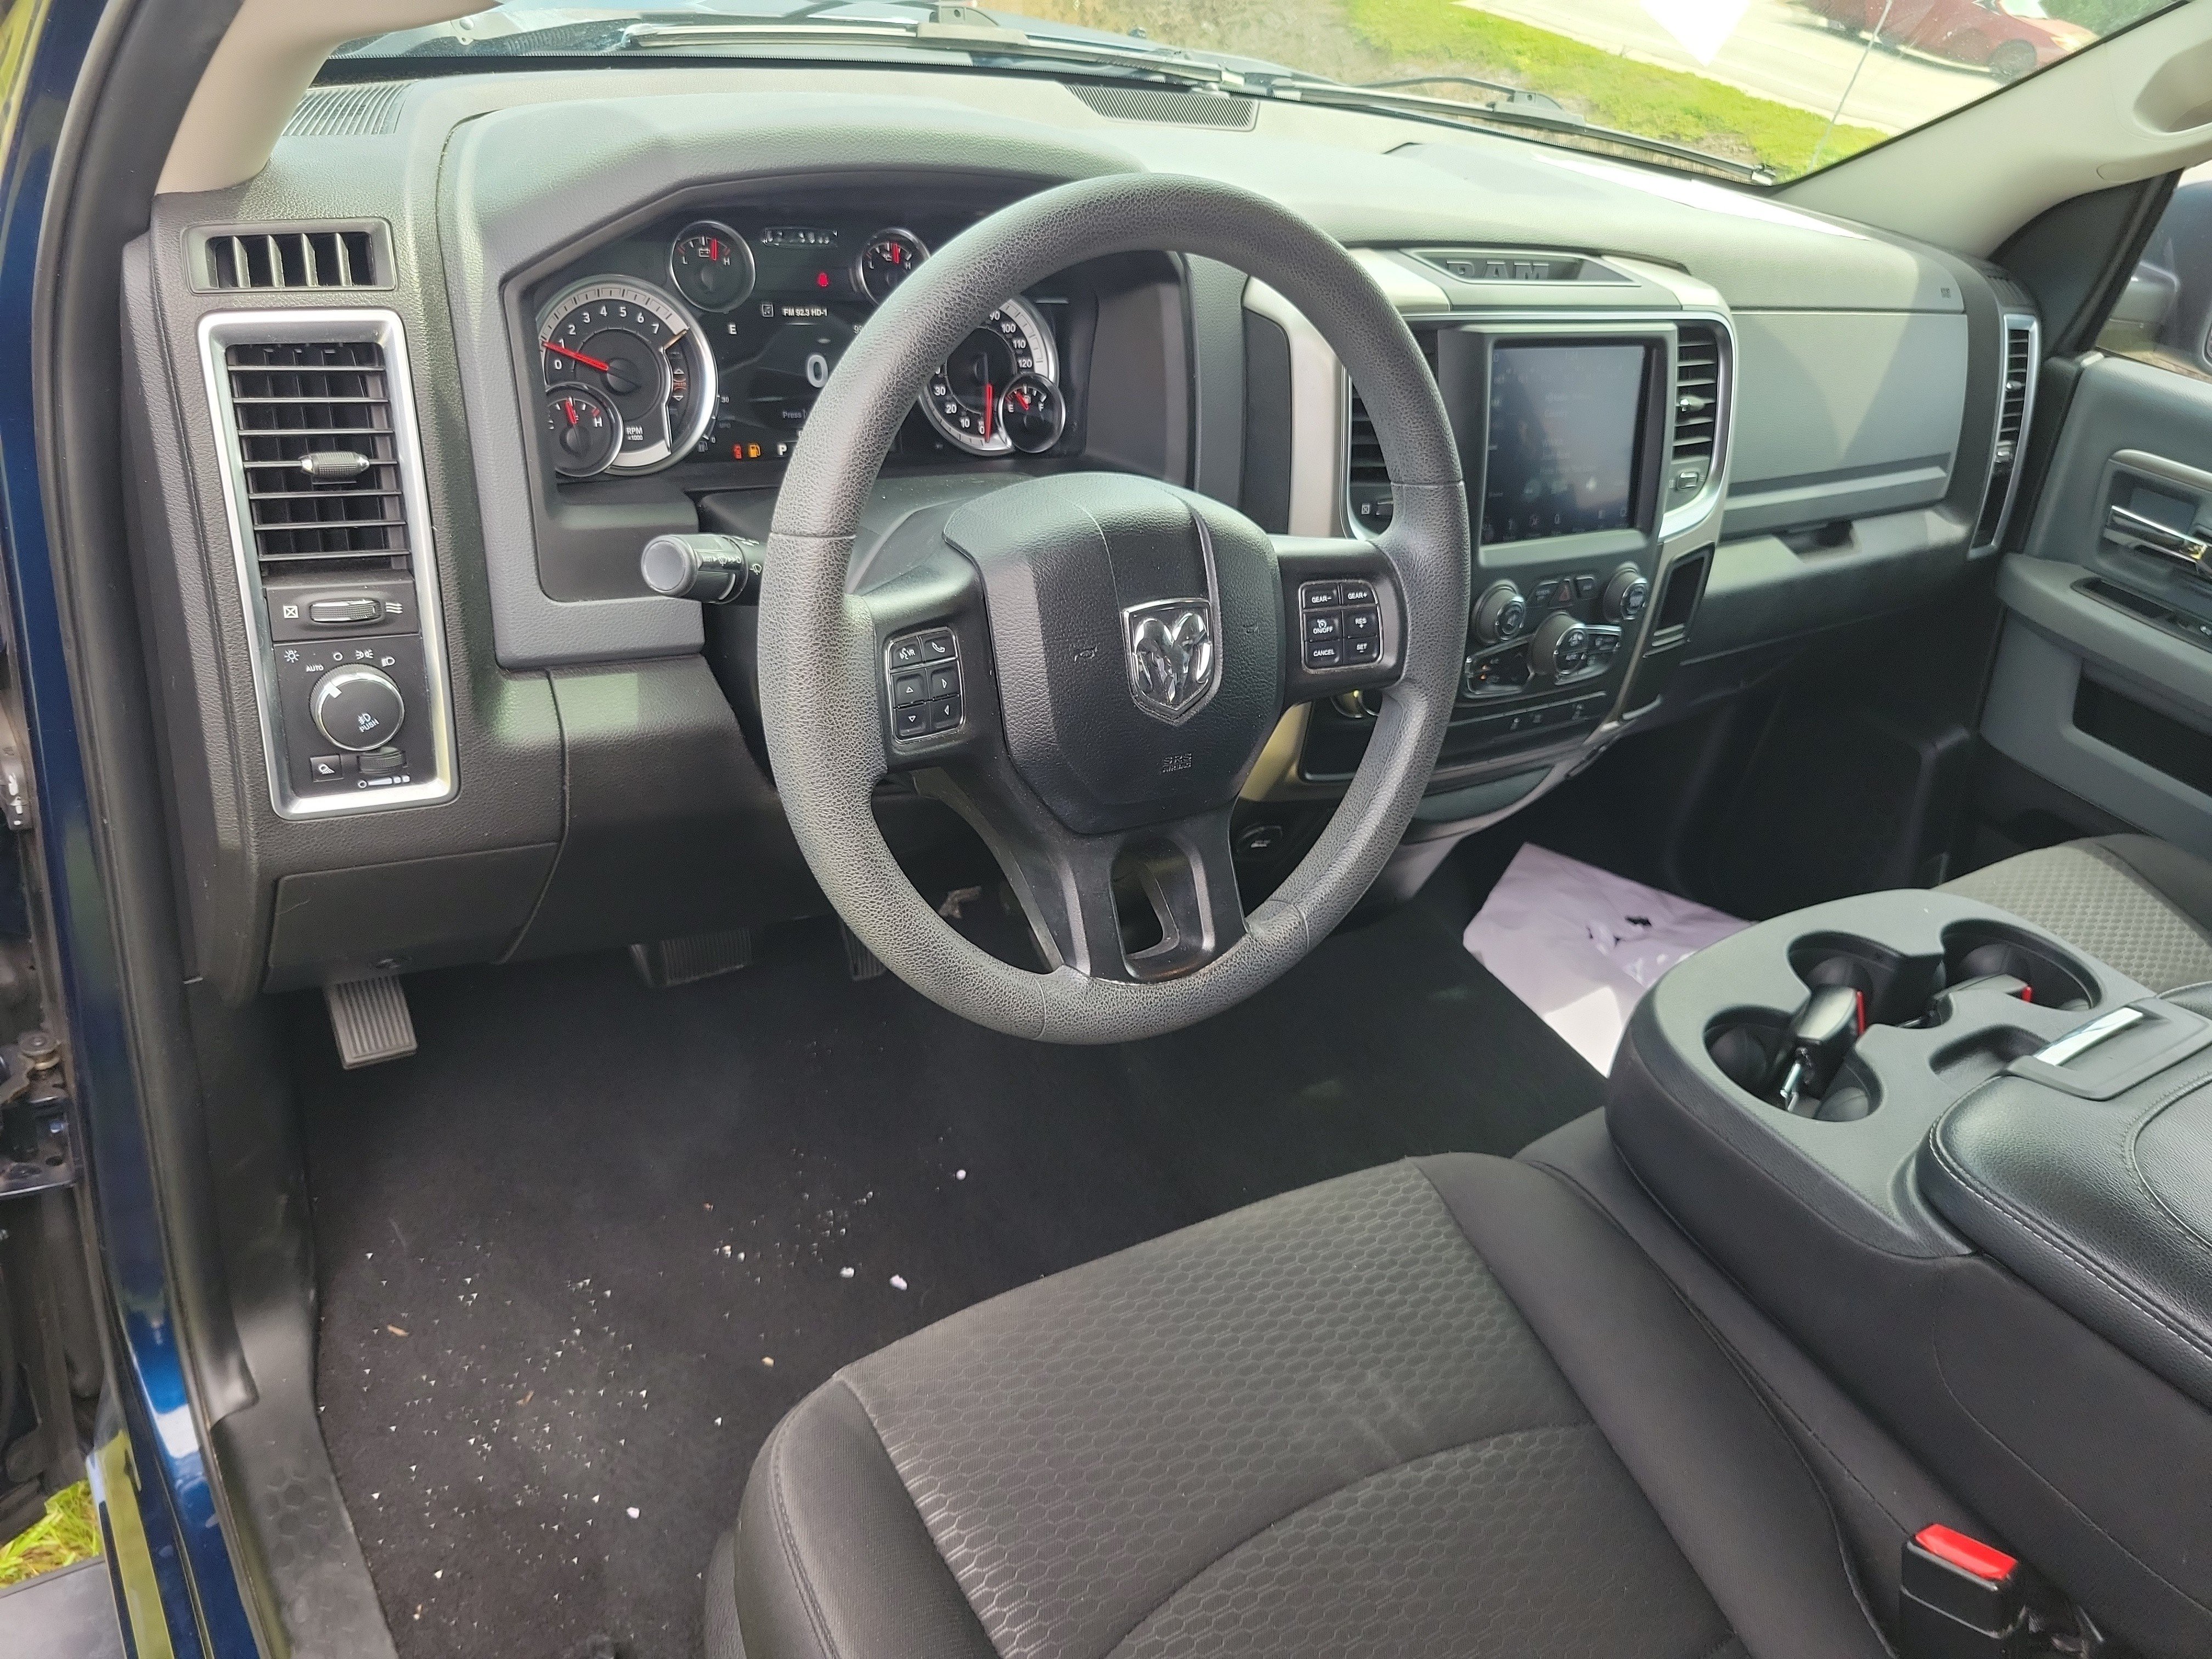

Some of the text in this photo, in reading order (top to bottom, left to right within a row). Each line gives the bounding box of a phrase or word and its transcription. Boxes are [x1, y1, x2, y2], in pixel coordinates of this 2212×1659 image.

[682, 256, 689, 264] L
[723, 256, 731, 266] H
[600, 305, 608, 317] 4
[619, 306, 627, 318] 5
[783, 307, 794, 317] FM
[811, 307, 827, 317] HD-1
[583, 312, 590, 323] 3
[637, 312, 645, 323] 6
[568, 324, 577, 335] 2
[652, 323, 659, 334] 7
[729, 323, 737, 335] E
[1001, 323, 1016, 333] 100
[558, 338, 565, 349] 1
[1013, 339, 1026, 349] 110
[554, 359, 562, 370] 0
[1018, 359, 1032, 369] 120
[807, 353, 828, 388] 0
[934, 386, 946, 396] 30
[945, 404, 957, 414] 20
[1008, 404, 1014, 413] E
[594, 417, 603, 427] H
[960, 418, 970, 428] 10
[627, 426, 643, 435] RPM
[777, 444, 787, 456] P
[1313, 626, 1333, 634] ON/OFF
[1313, 648, 1335, 657] CANCEL
[306, 664, 324, 673] AUTO
[358, 718, 380, 733] PUSH
